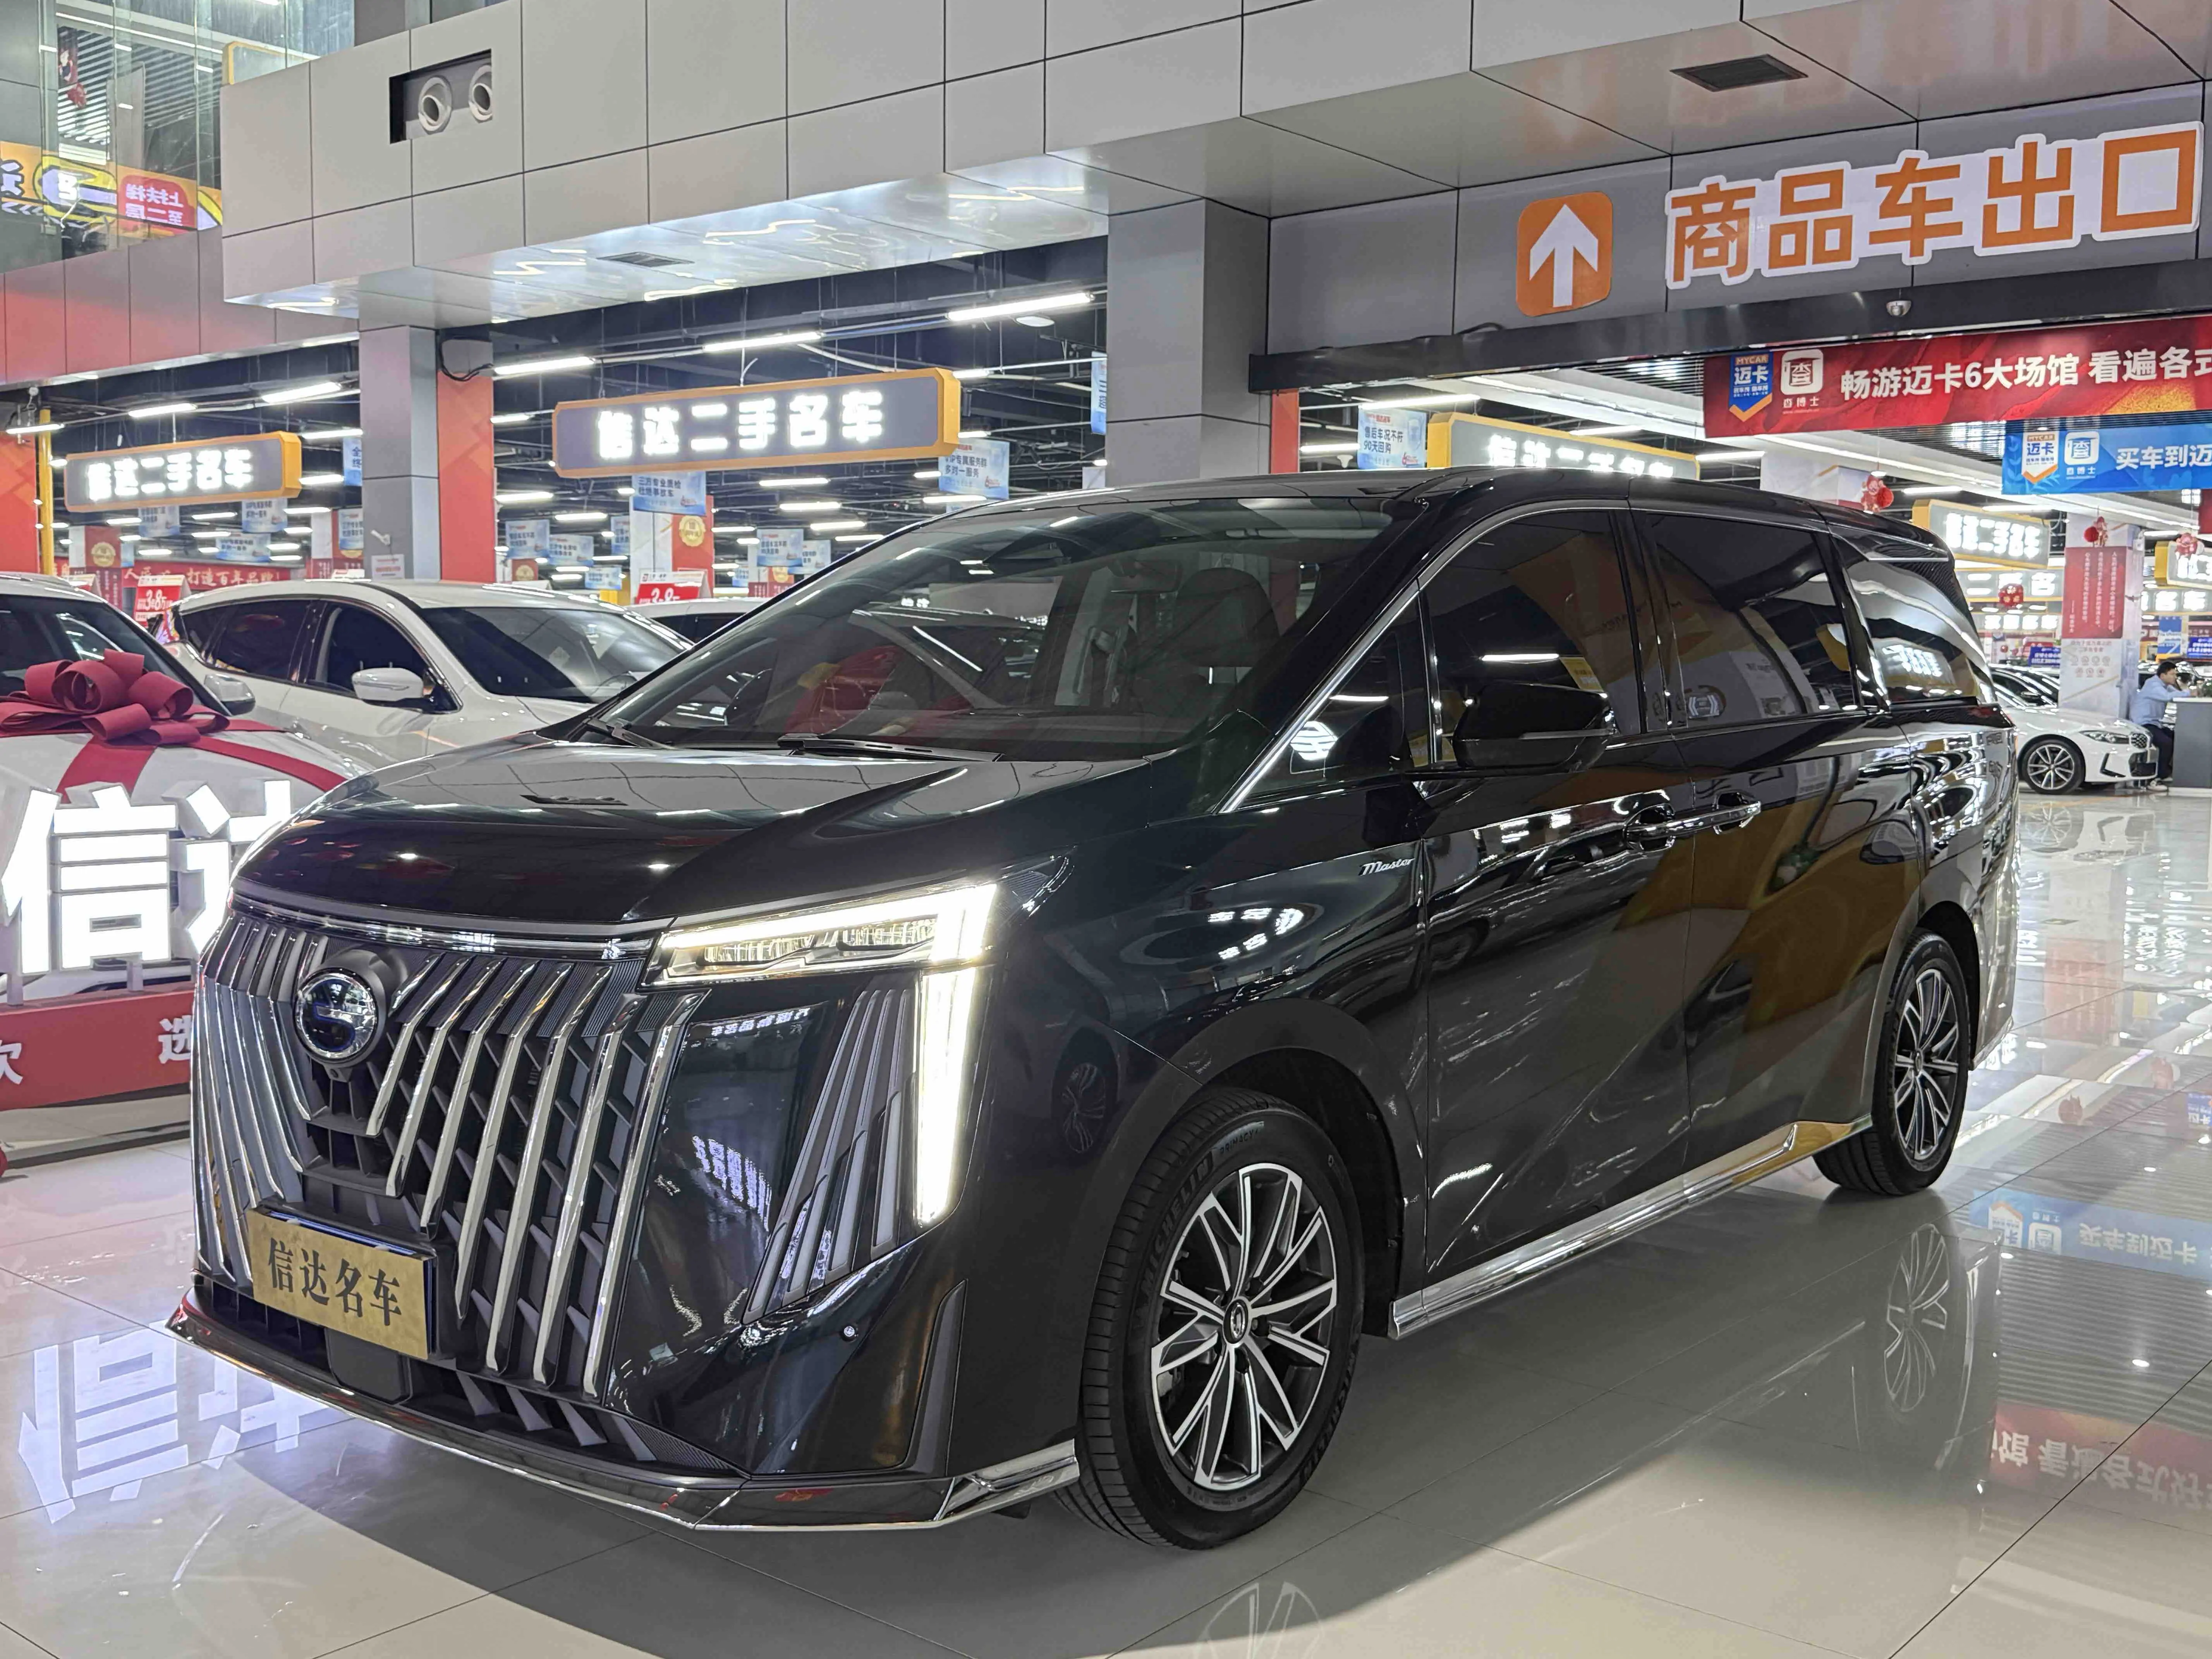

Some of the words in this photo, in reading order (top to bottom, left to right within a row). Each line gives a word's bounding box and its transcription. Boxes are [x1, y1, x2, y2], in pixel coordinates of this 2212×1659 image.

[1671, 129, 2198, 283] 商品车出口
[1736, 355, 1768, 365] MYCAR
[1734, 365, 1769, 385] 迈卡
[1841, 353, 2079, 400] 畅游迈卡6大场馆
[1364, 426, 1403, 443] 售后车况不符
[1363, 440, 1391, 454] 90天回购
[2027, 442, 2054, 456] 迈卡
[2115, 444, 2212, 470] 买车到迈
[1358, 858, 1416, 876] Master
[1142, 1157, 1210, 1293] MICHELIN
[268, 1237, 402, 1326] 信达名车
